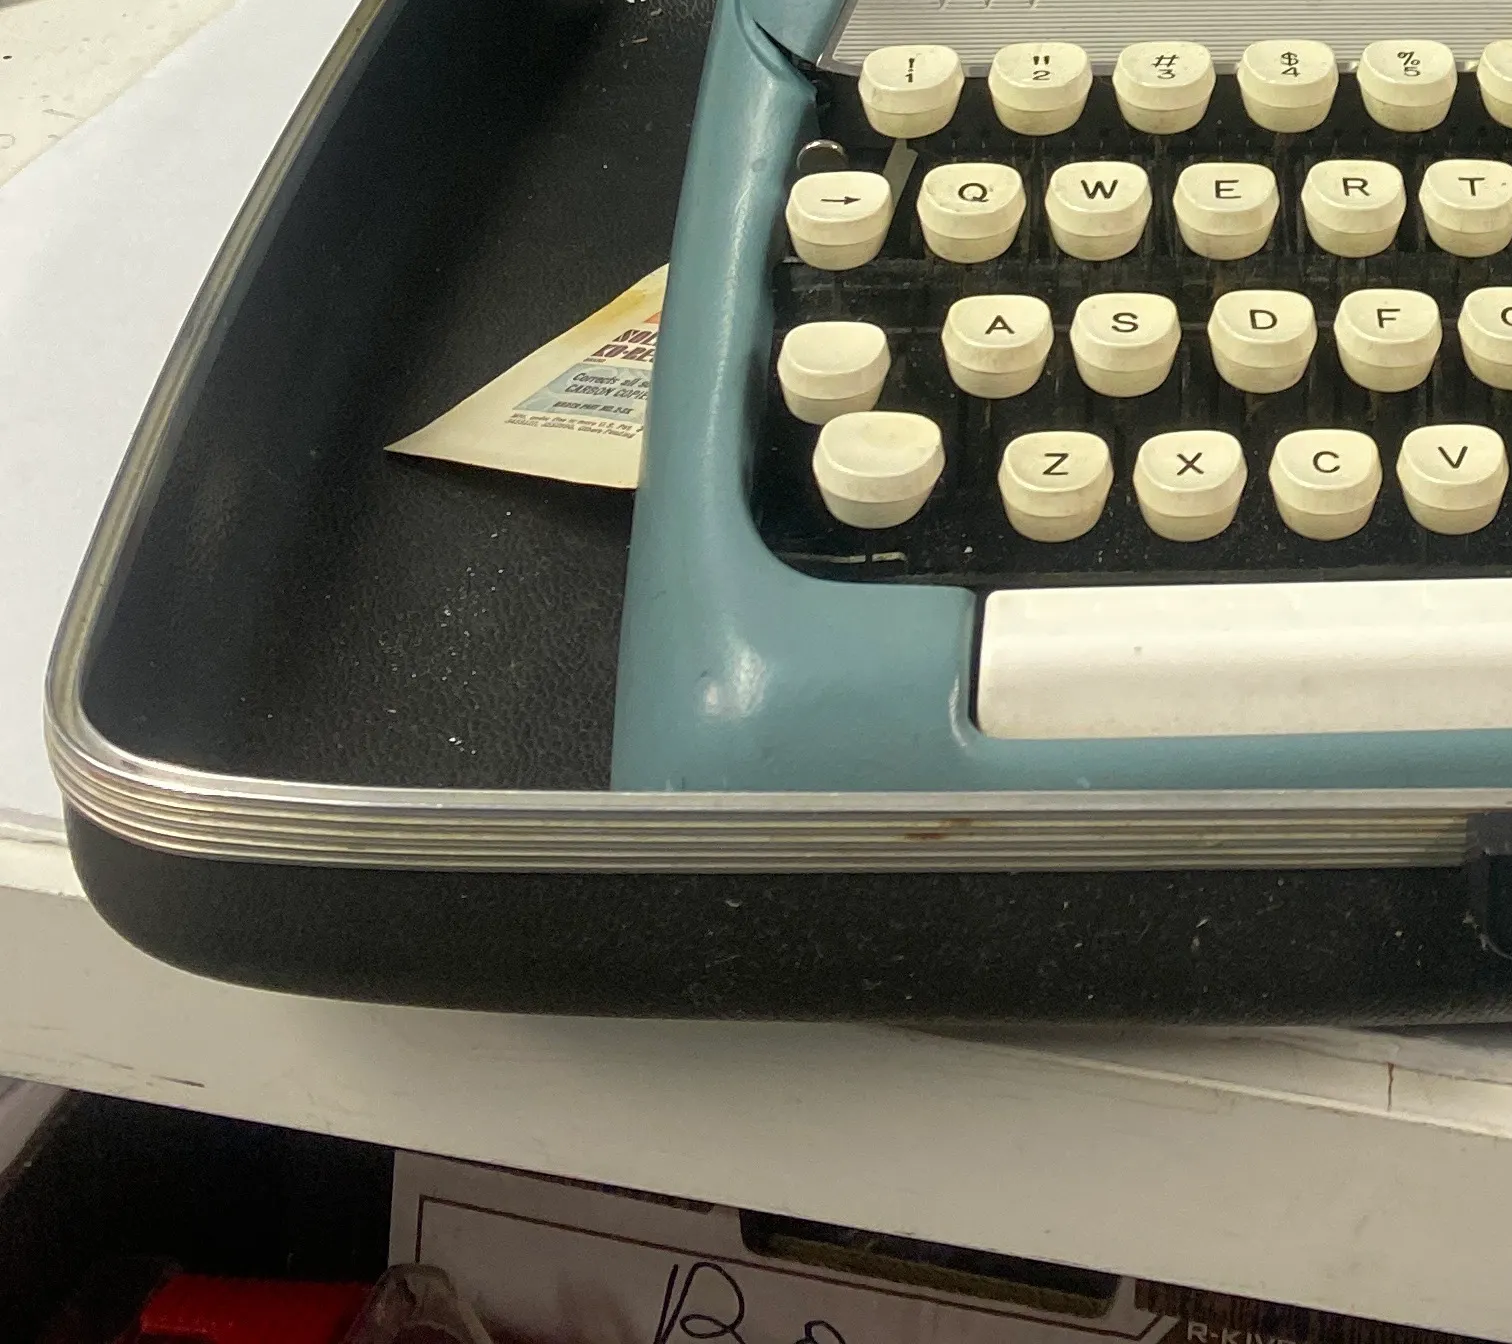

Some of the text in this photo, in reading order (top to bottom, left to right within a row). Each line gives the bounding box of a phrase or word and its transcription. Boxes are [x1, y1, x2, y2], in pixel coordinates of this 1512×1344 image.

[1152, 54, 1179, 68] #
[1280, 51, 1299, 67] $
[1397, 51, 1421, 66] %
[905, 69, 914, 83] 1
[1032, 70, 1051, 81] 2
[1157, 68, 1176, 80] 3
[1281, 66, 1301, 78] 4
[1403, 66, 1421, 77] 5
[957, 182, 989, 203] Q
[1080, 179, 1119, 200] W
[1214, 179, 1242, 200] E
[1342, 177, 1370, 197] R
[1458, 177, 1485, 197] T
[984, 314, 1015, 335] A
[1111, 312, 1139, 333] S
[1249, 309, 1278, 330] D
[1376, 308, 1401, 329] F
[573, 372, 619, 384] Corrects
[620, 377, 638, 387] all
[565, 384, 648, 400] CARBON COPIE
[1042, 452, 1069, 476] Z
[1176, 452, 1205, 476] X
[1312, 450, 1341, 474] C
[1437, 445, 1469, 469] V
[1187, 1321, 1302, 1344] R-KI
